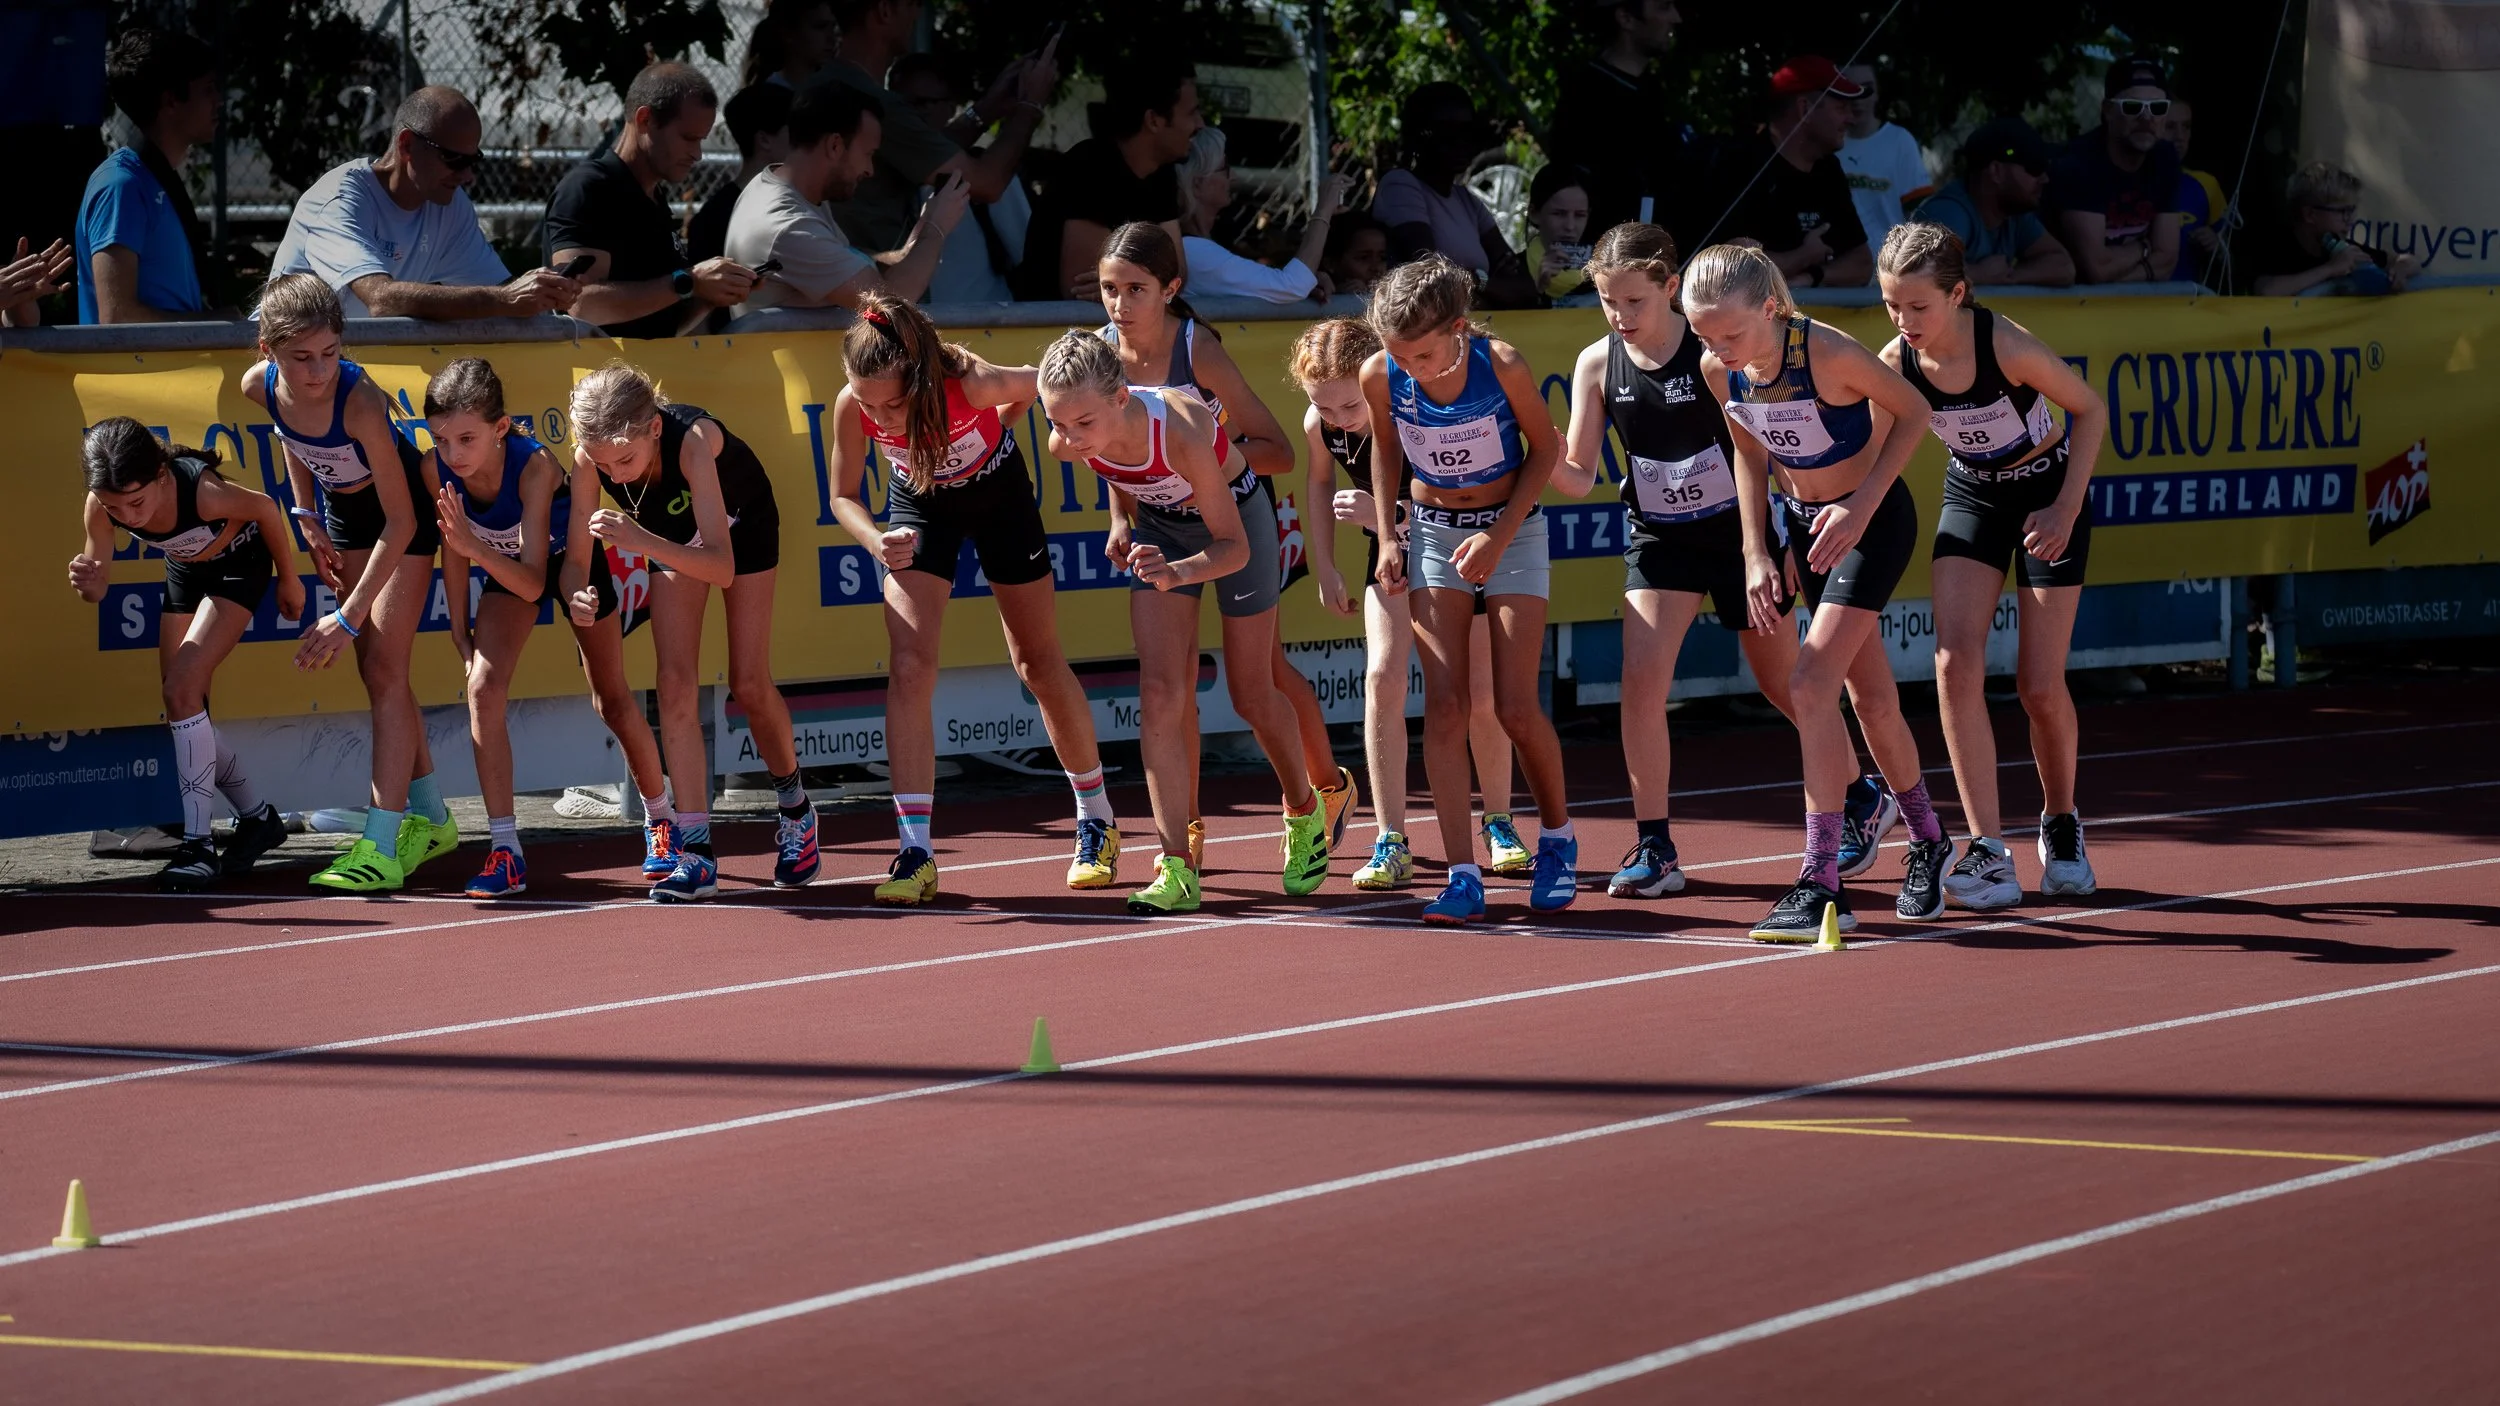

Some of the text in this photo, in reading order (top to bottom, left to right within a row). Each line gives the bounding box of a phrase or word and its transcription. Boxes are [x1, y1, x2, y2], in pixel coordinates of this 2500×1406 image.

[1942, 403, 1969, 411] CRAFT
[1761, 430, 1801, 447] 166
[1958, 430, 1990, 445] 58
[976, 434, 1016, 482] NIKE
[1428, 449, 1473, 467] 162
[1963, 444, 1996, 452] CHASSOT
[1438, 467, 1468, 475] KOHLER
[1996, 457, 2051, 483] PRO
[1662, 483, 1704, 505] 315
[2089, 473, 2342, 519] ITZERLAND
[2367, 470, 2429, 529] AOP
[1411, 504, 1452, 526] IKE
[1671, 502, 1702, 513] TOWERS
[480, 536, 520, 550] 316
[2322, 599, 2500, 629] GWIDEMSTRASSE 7 41
[947, 714, 1035, 747] Spengler
